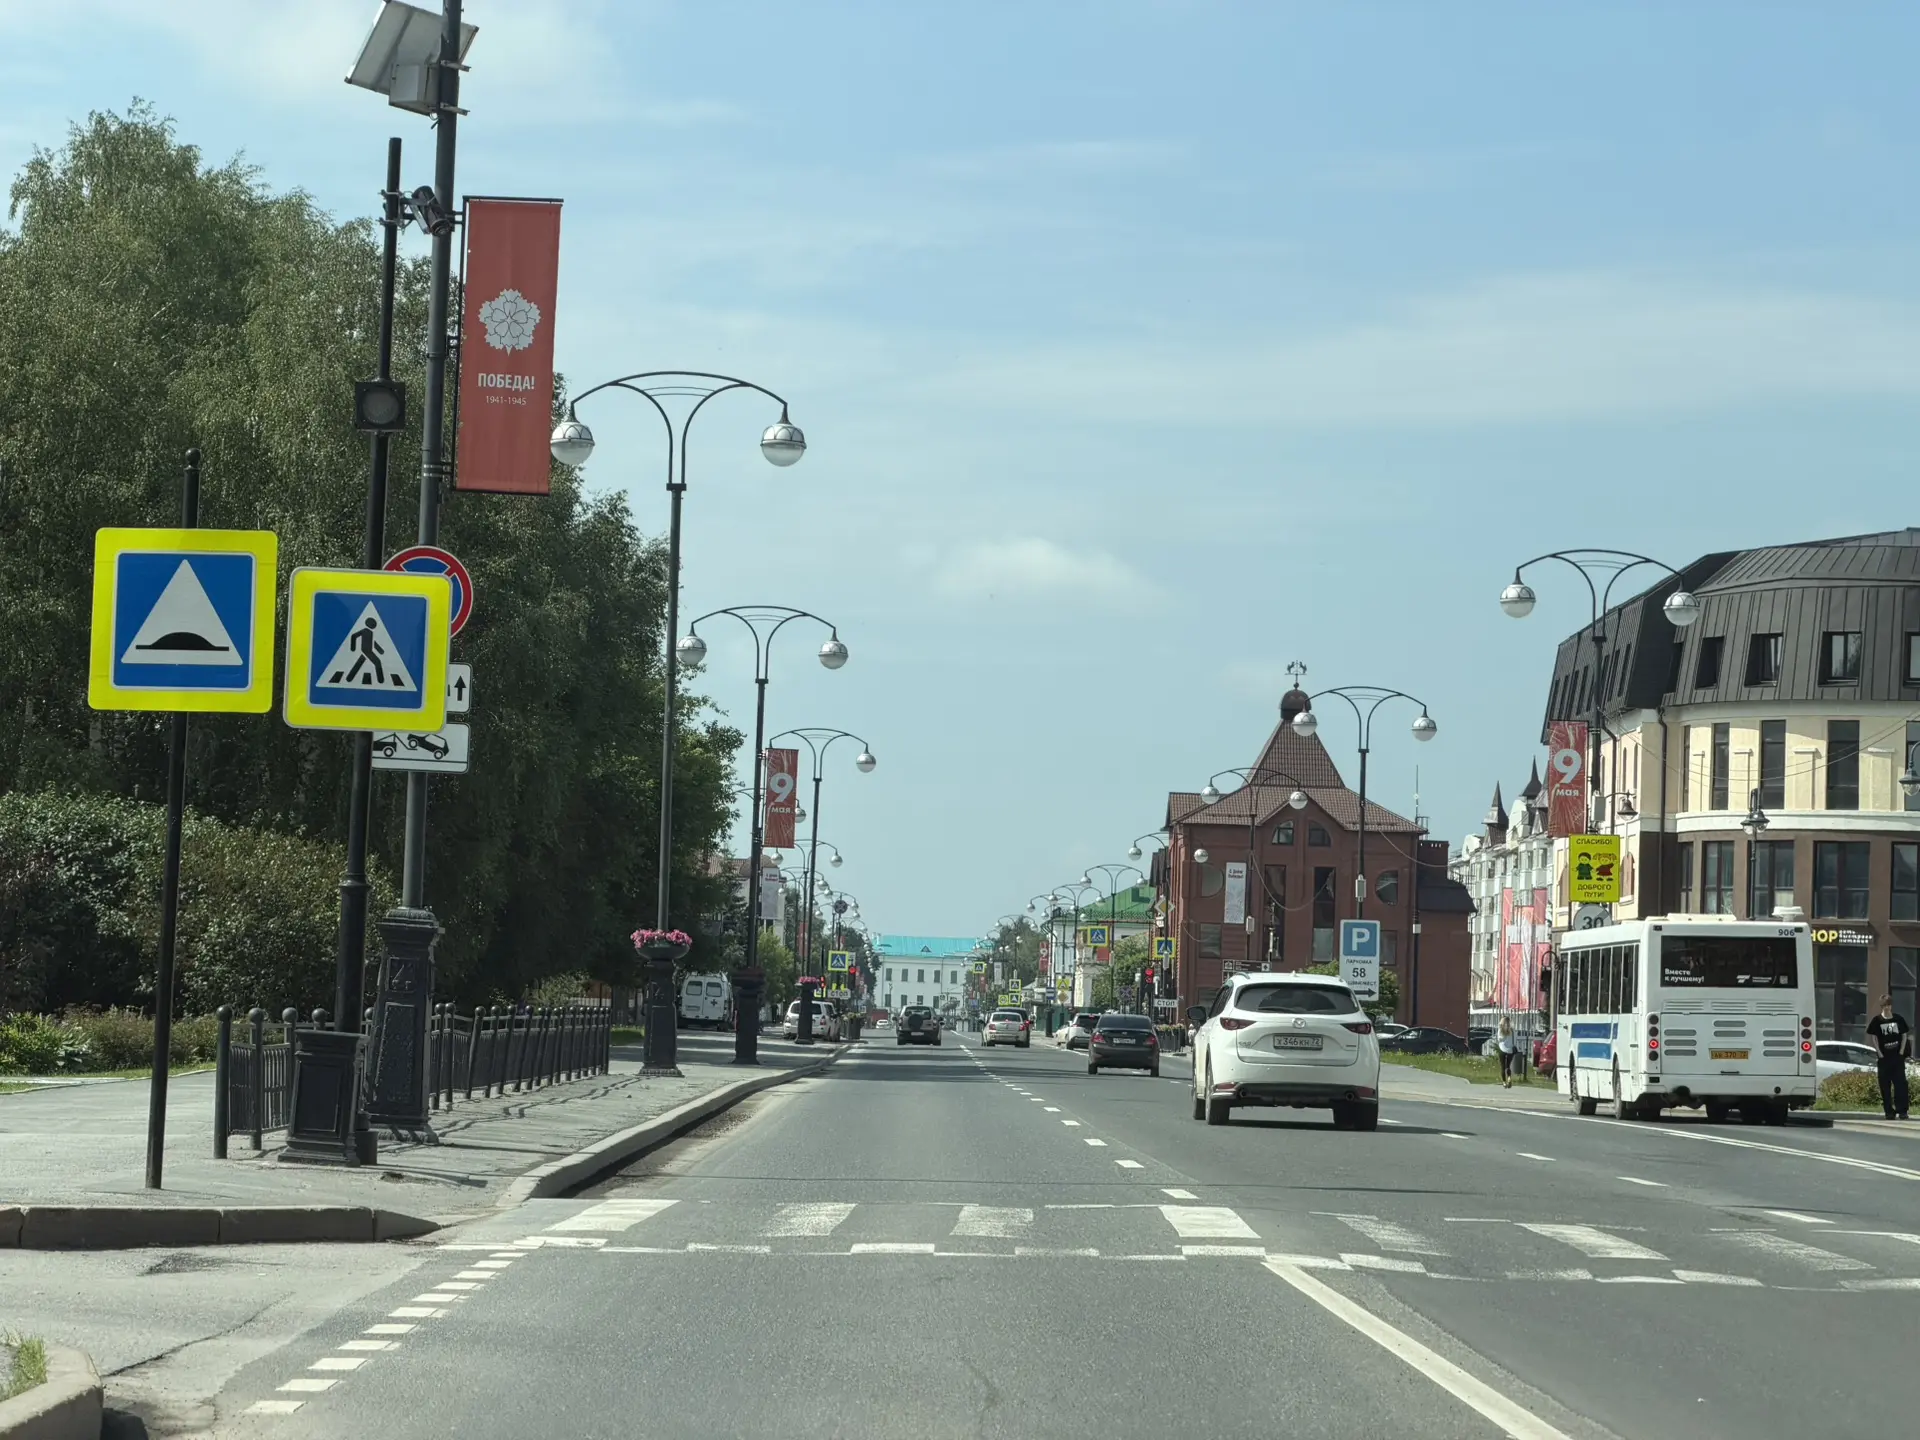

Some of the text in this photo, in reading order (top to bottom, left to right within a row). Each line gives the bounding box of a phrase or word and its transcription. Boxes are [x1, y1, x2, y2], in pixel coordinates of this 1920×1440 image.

[478, 373, 535, 391] ПОБЕДА!
[485, 395, 527, 406] 1941-1945
[1553, 748, 1582, 785] 9
[769, 772, 794, 803] 9
[1555, 788, 1579, 797] мая
[1577, 883, 1612, 892] ДОБРОГО
[1582, 916, 1604, 930] 30
[1777, 928, 1795, 937] 906
[1351, 927, 1371, 951] P
[1352, 967, 1366, 978] 58
[1670, 975, 1705, 984] лучшему!
